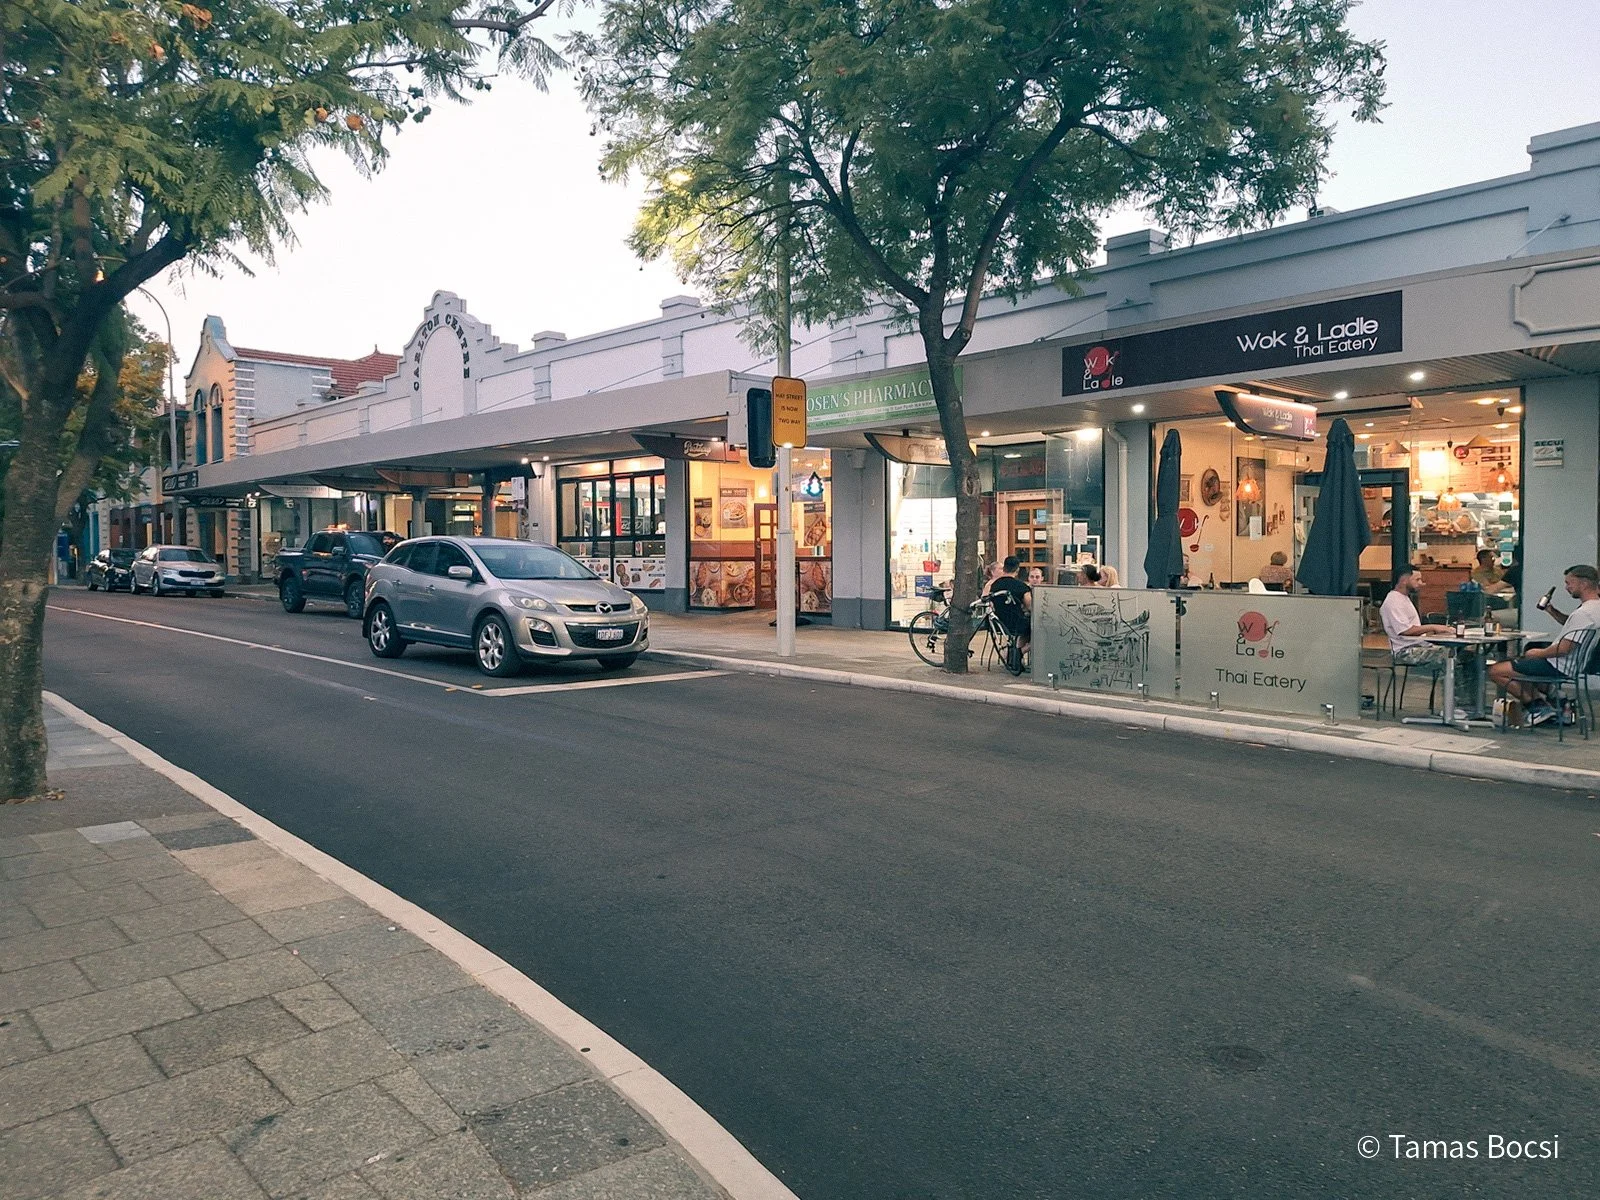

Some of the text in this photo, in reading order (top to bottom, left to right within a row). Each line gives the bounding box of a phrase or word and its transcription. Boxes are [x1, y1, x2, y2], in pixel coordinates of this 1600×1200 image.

[1236, 316, 1379, 352] Wok & Ladle
[1293, 337, 1378, 358] Thai Eatery
[786, 393, 803, 401] STREET
[806, 379, 935, 412] OSEN'S PHARMACY
[1215, 668, 1306, 693] Thai Eatery
